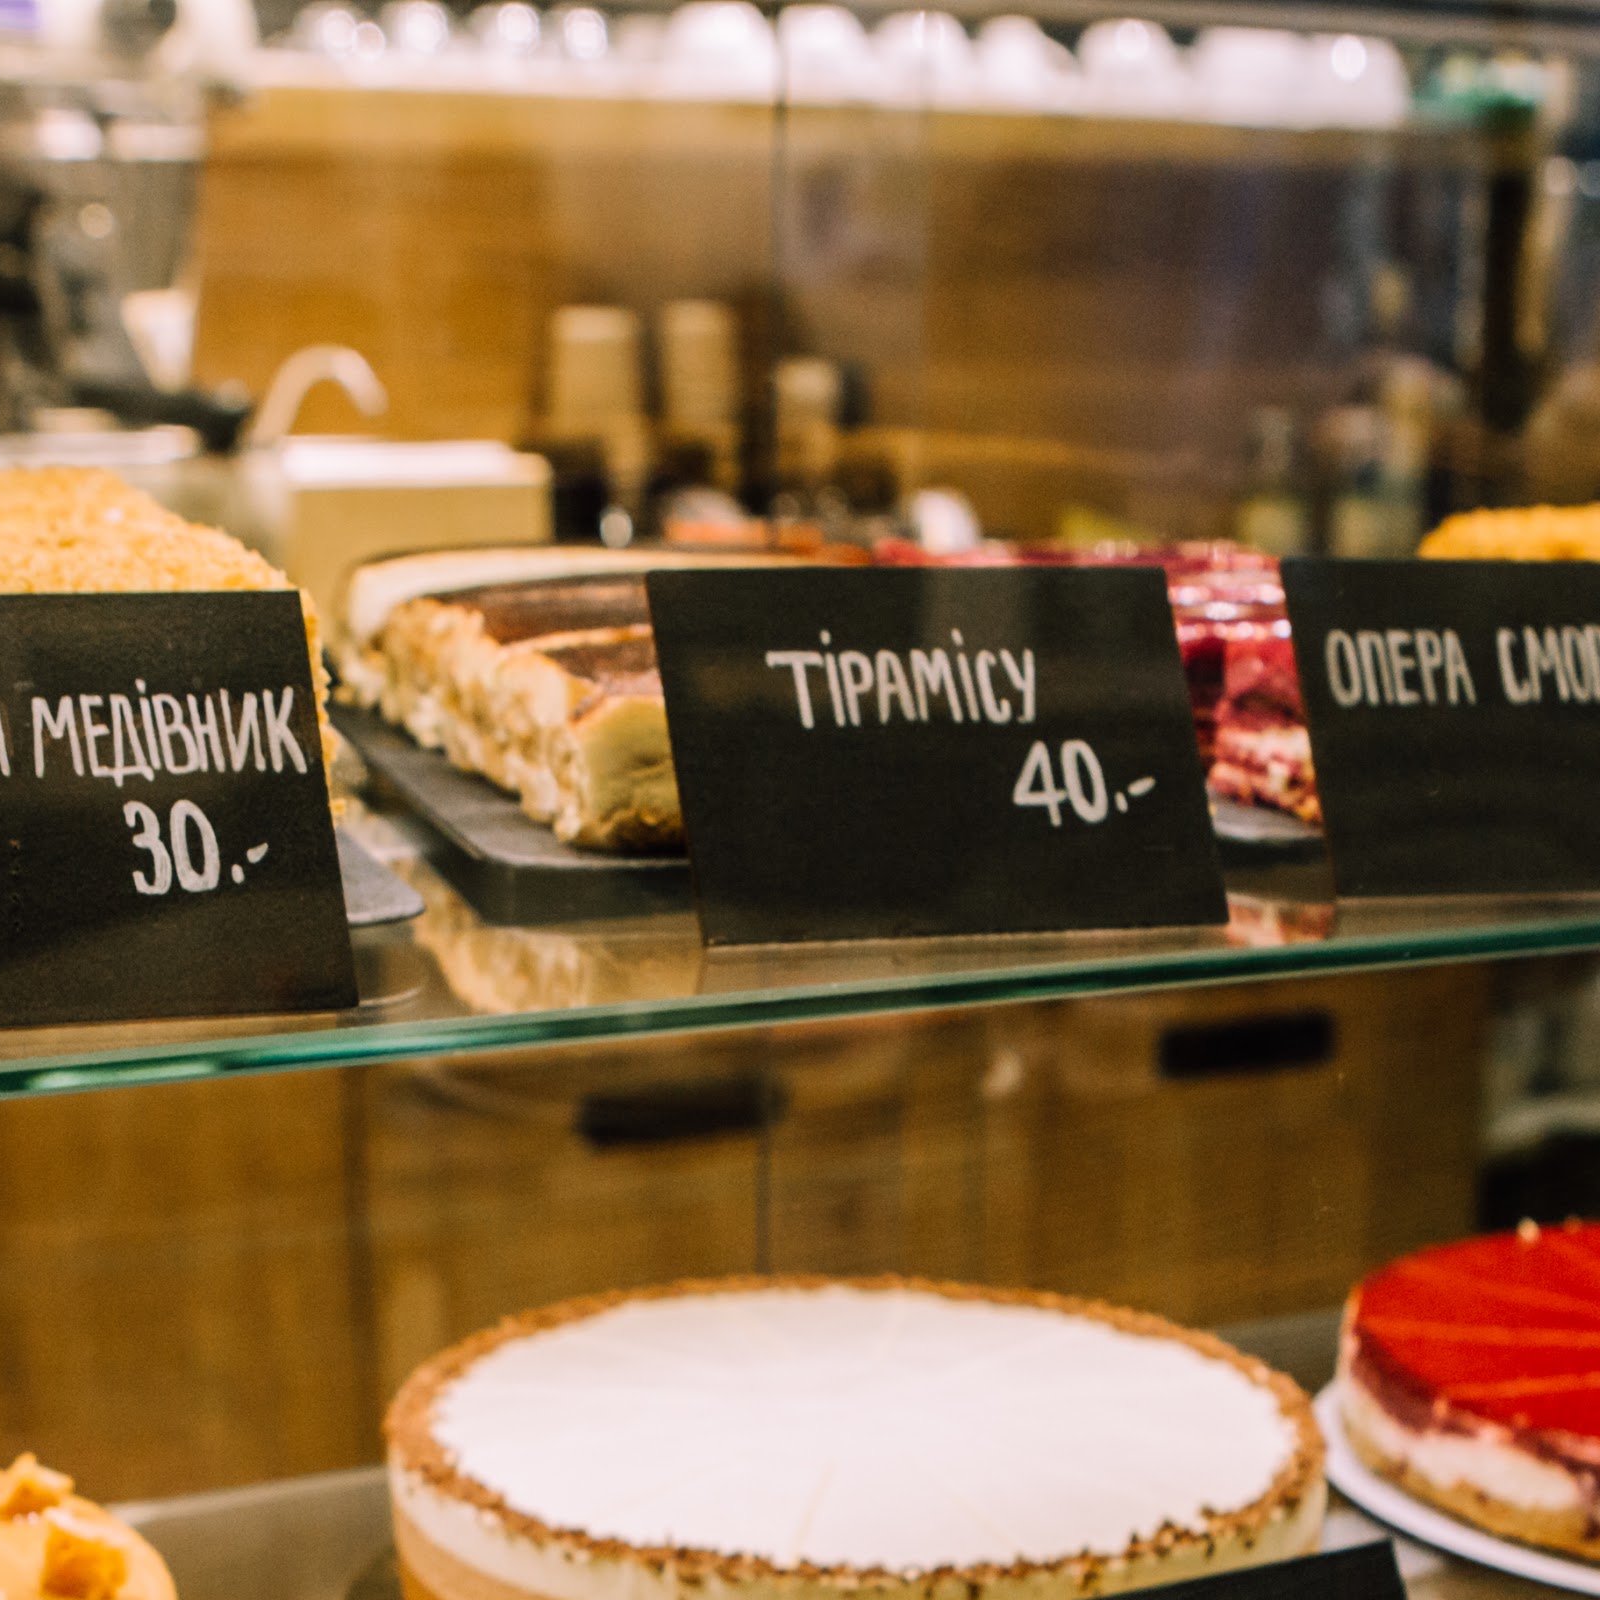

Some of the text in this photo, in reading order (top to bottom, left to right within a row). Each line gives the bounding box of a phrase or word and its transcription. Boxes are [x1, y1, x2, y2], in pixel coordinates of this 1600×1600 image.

[765, 628, 1036, 729] ТІРАМІСУ
[1323, 626, 1477, 706] ОПЕРА
[30, 679, 308, 787] МЕДІВНИК
[1012, 738, 1157, 827] 40.-
[123, 799, 269, 895] 30.-
